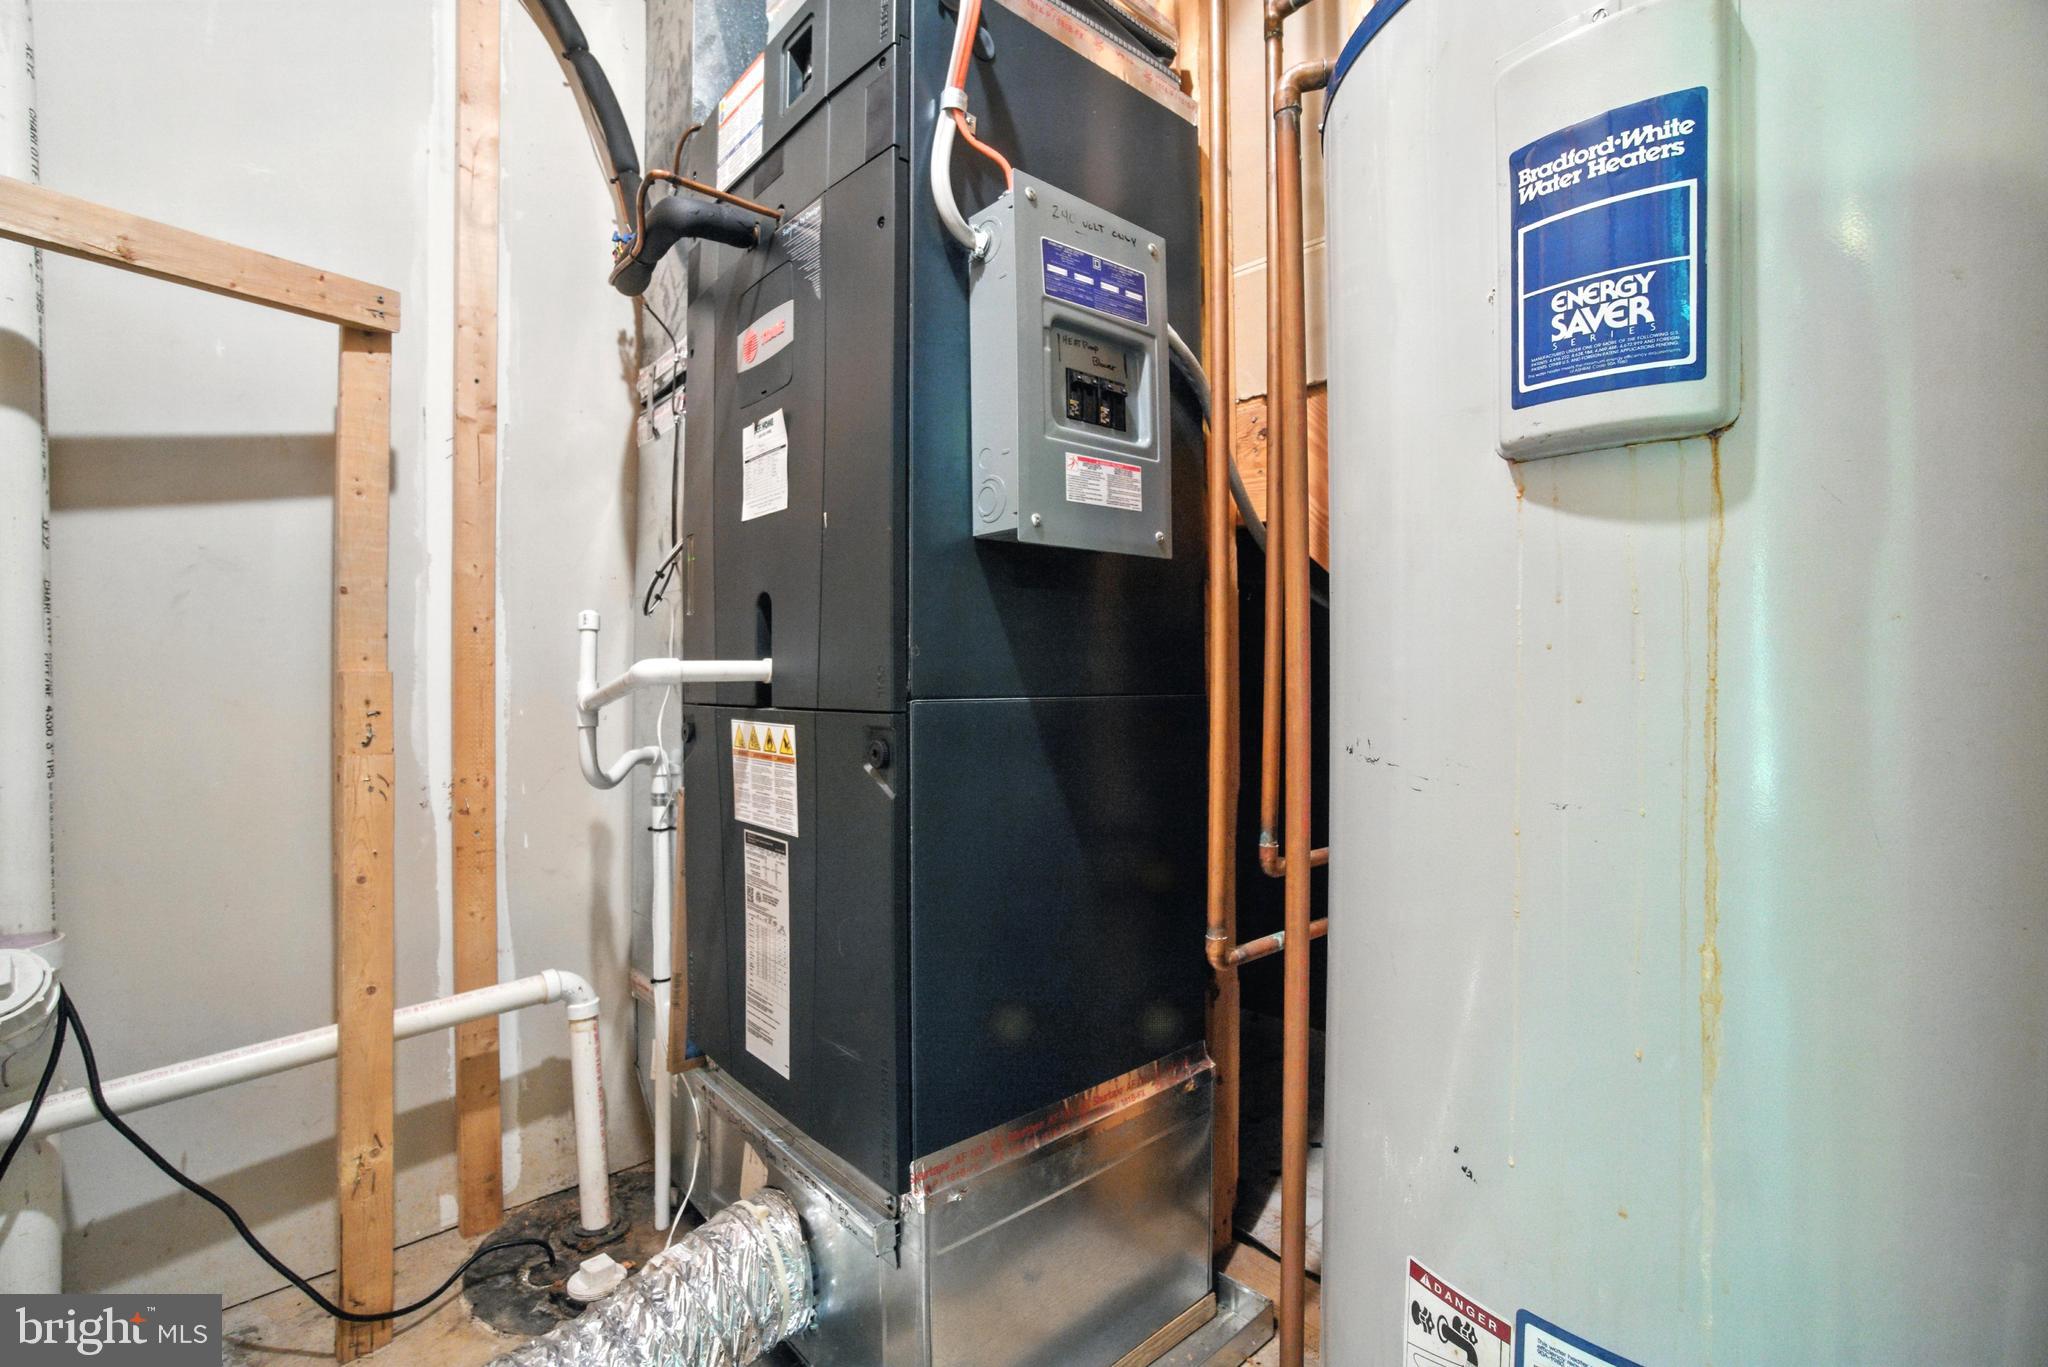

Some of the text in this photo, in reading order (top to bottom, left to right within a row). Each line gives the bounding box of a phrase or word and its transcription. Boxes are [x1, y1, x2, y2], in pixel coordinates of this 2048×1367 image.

[1518, 140, 1685, 205] Water Heaters
[1551, 271, 1656, 313] ENERGY
[1551, 295, 1655, 343] SAVER
[1553, 322, 1656, 350] SERIES
[1637, 331, 1669, 341] FOLLOWING
[1434, 1282, 1498, 1333] DANGER
